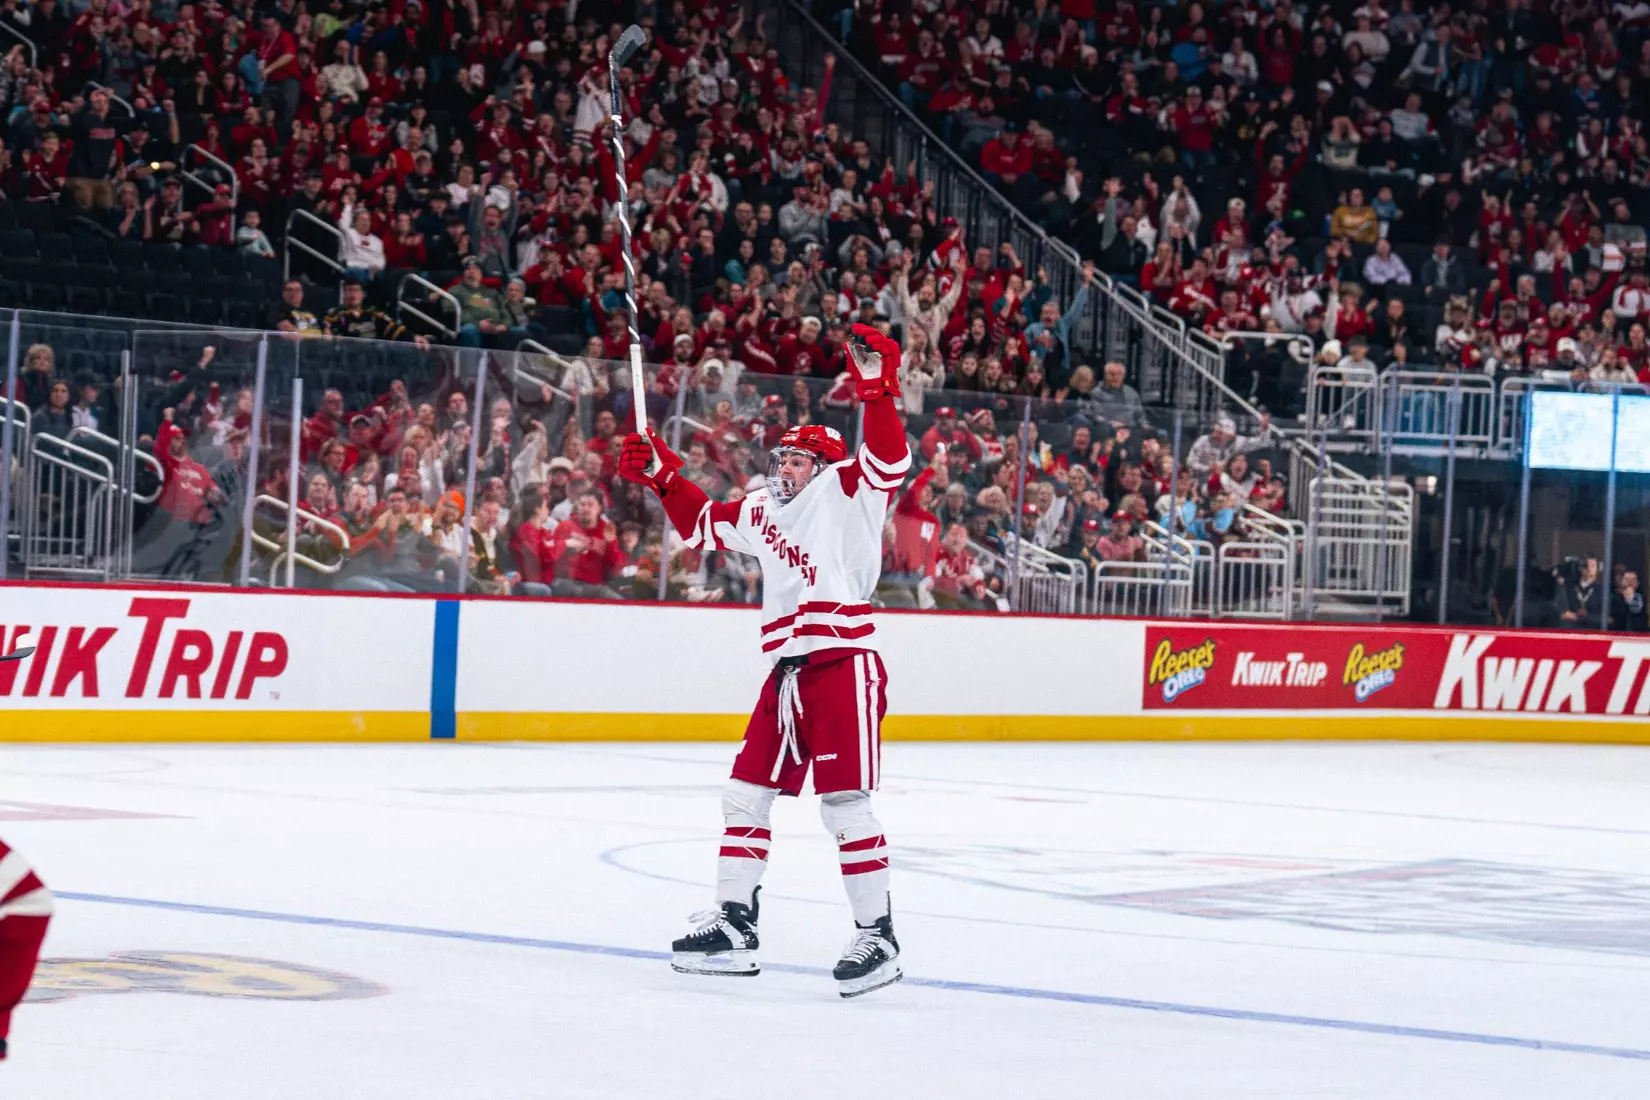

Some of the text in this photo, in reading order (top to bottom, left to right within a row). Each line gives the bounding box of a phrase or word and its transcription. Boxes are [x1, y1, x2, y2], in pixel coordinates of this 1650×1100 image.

[125, 596, 289, 700] TRIP
[1231, 651, 1329, 687] KWIK TRIP
[1433, 632, 1604, 713] KWIK
